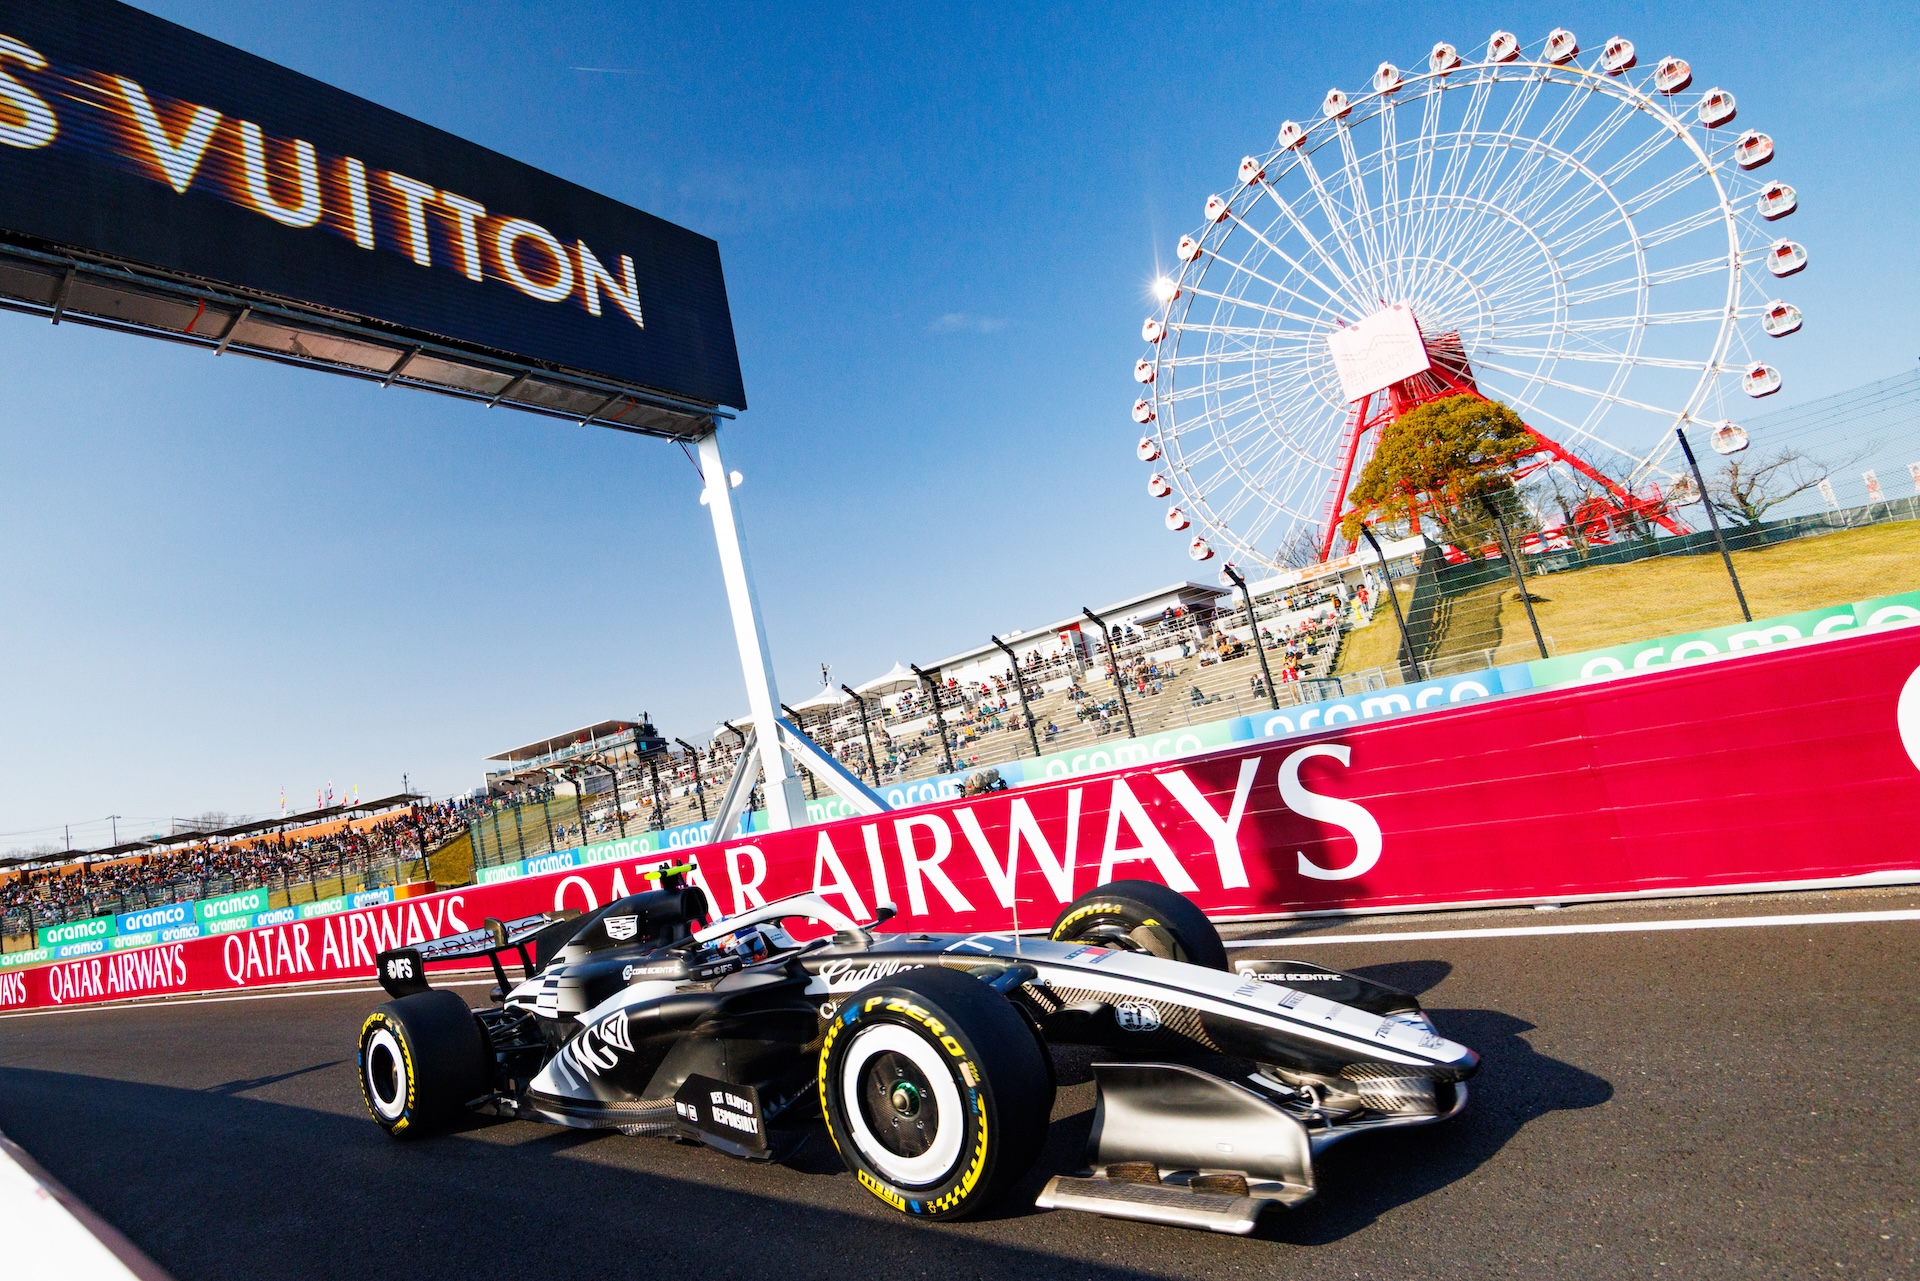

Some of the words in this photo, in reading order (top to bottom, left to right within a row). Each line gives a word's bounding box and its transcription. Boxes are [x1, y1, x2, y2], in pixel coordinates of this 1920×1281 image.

[115, 74, 645, 329] VUITTON
[887, 777, 963, 807] aram
[807, 744, 1383, 925] AIRWAYS
[587, 837, 650, 862] aramco
[528, 852, 573, 875] aramco
[204, 894, 260, 918] aramco
[257, 908, 294, 926] aramco
[304, 899, 342, 917] aramco
[126, 907, 185, 931] aramco
[210, 917, 247, 933] aramco
[47, 919, 107, 943] aramco
[114, 933, 152, 948] aramco
[162, 925, 199, 941] aramco
[224, 923, 315, 985] QATAR
[321, 896, 469, 970] AIRWAYS
[2, 949, 48, 966] aramco
[61, 940, 103, 956] aramco
[49, 959, 105, 1004] QATAR
[107, 943, 187, 995] AIRWAYS
[396, 957, 414, 979] IFS
[632, 966, 647, 975] CORE
[647, 965, 681, 975] SCIENTIFIC
[720, 963, 734, 974] IFS
[1257, 973, 1286, 981] CORE
[1286, 973, 1343, 981] SCIENTIFIC
[1278, 989, 1308, 1010] PIRELL
[885, 997, 966, 1057] ZERO
[1117, 1006, 1157, 1027] FIA
[711, 1105, 759, 1134] RESPONSIBLY
[858, 1168, 906, 1213] PIRELLI
